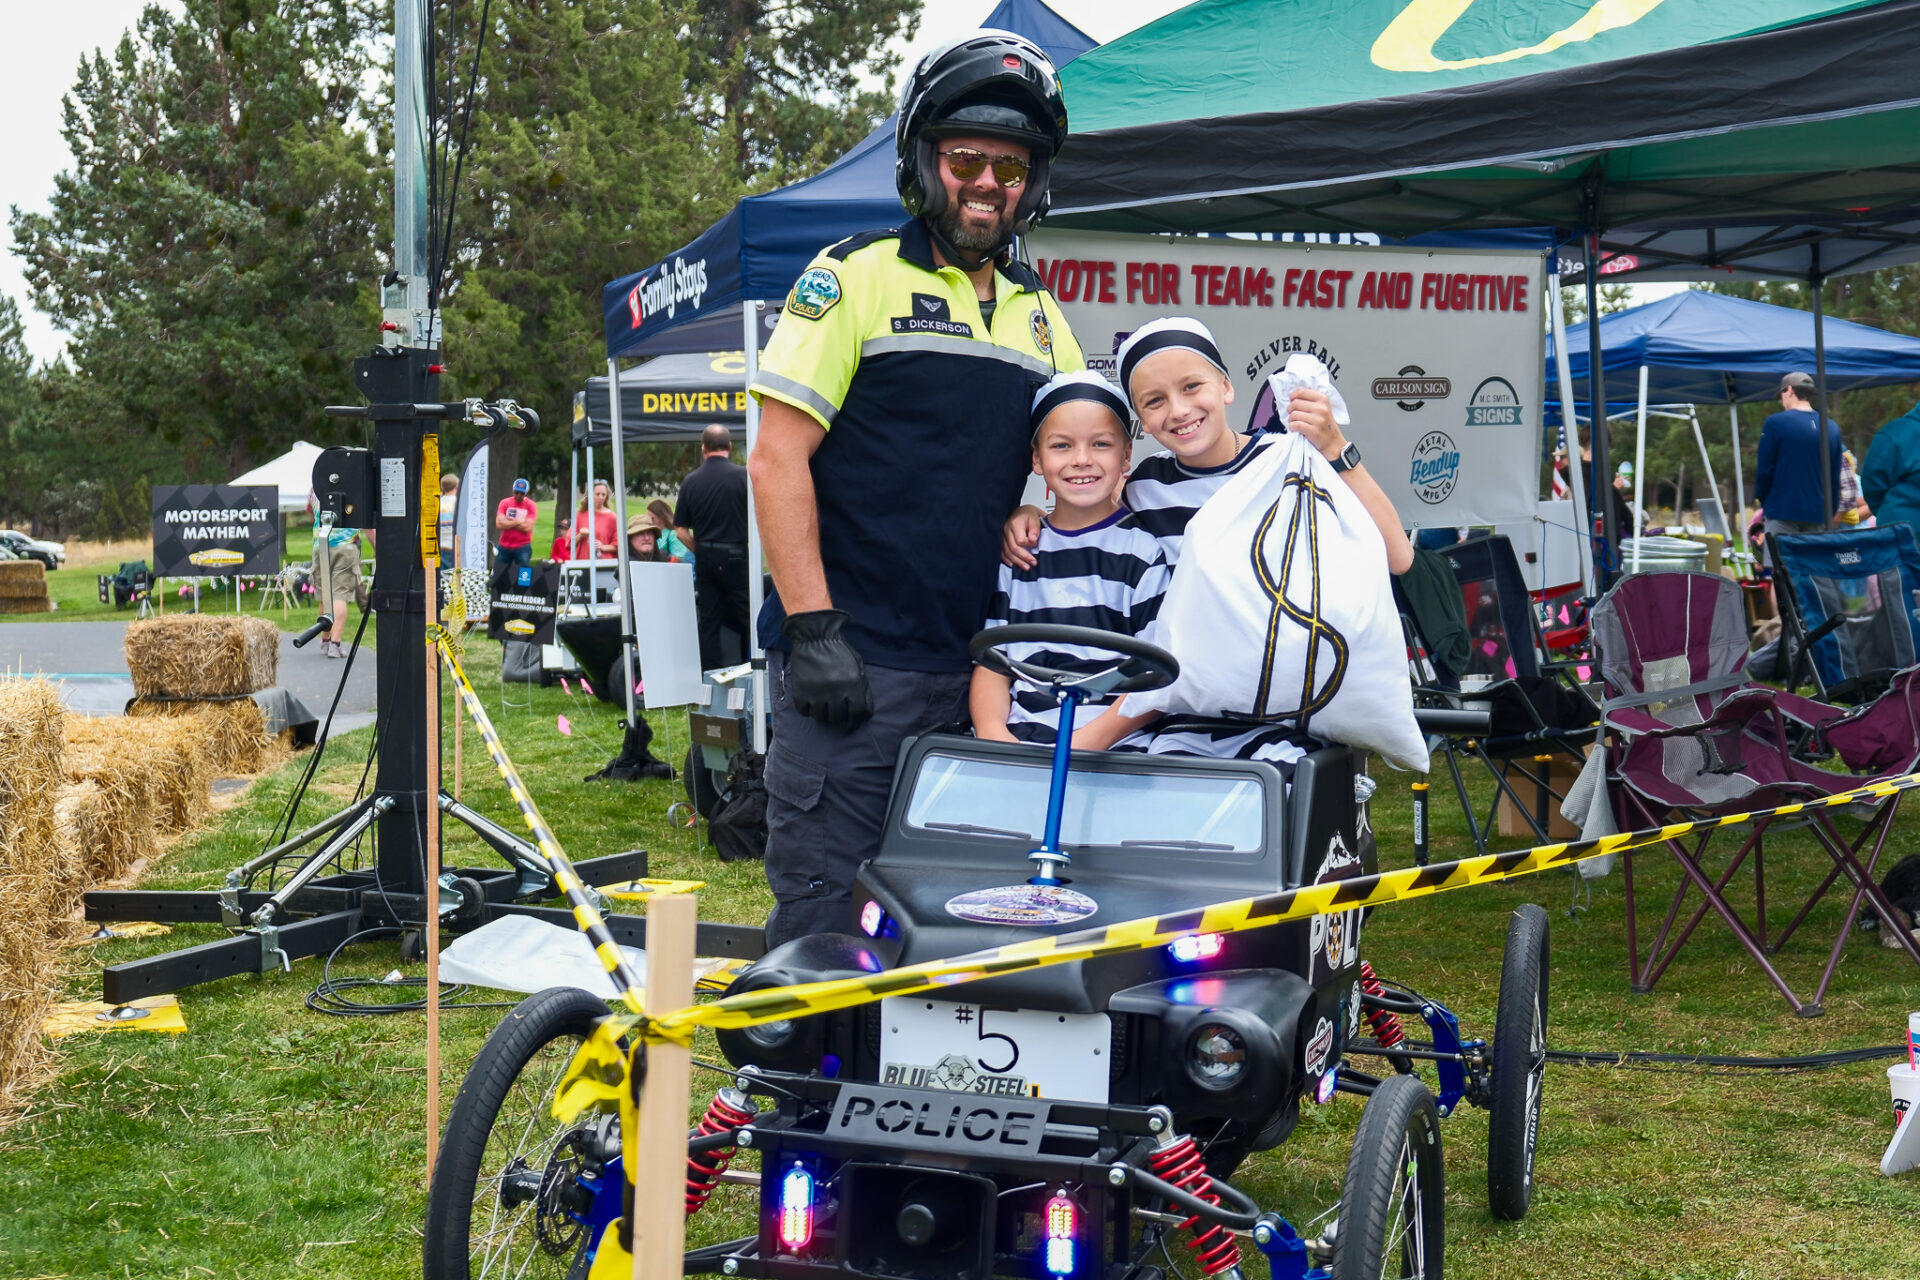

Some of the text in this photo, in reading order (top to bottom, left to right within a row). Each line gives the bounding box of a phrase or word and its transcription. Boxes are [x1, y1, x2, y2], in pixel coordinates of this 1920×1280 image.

[812, 270, 831, 282] BEND
[638, 256, 708, 319] Family Stays
[1037, 258, 1528, 312] VOTE FOR TEAM: FAST AND FUGITIVE
[795, 302, 817, 315] POLICE
[894, 319, 971, 335] S. DICKERSON
[1087, 359, 1117, 370] COM
[1246, 335, 1341, 381] SILVER RAIL
[1375, 382, 1447, 394] CARLSON SIGN
[643, 392, 728, 413] DRIVEN
[1492, 394, 1510, 403] SMITH
[1473, 408, 1515, 424] SIGNS
[1418, 436, 1447, 454] METAL
[1422, 481, 1452, 500] MFG CO
[164, 508, 268, 523] MOTORSPORT
[183, 526, 250, 540] MAYHEM
[523, 594, 546, 605] RIDERS
[883, 1065, 938, 1089] BLUE
[973, 1074, 1028, 1097] STEEL
[840, 1095, 1036, 1146] POLICE
[1528, 1107, 1538, 1149] ODYSSEY
